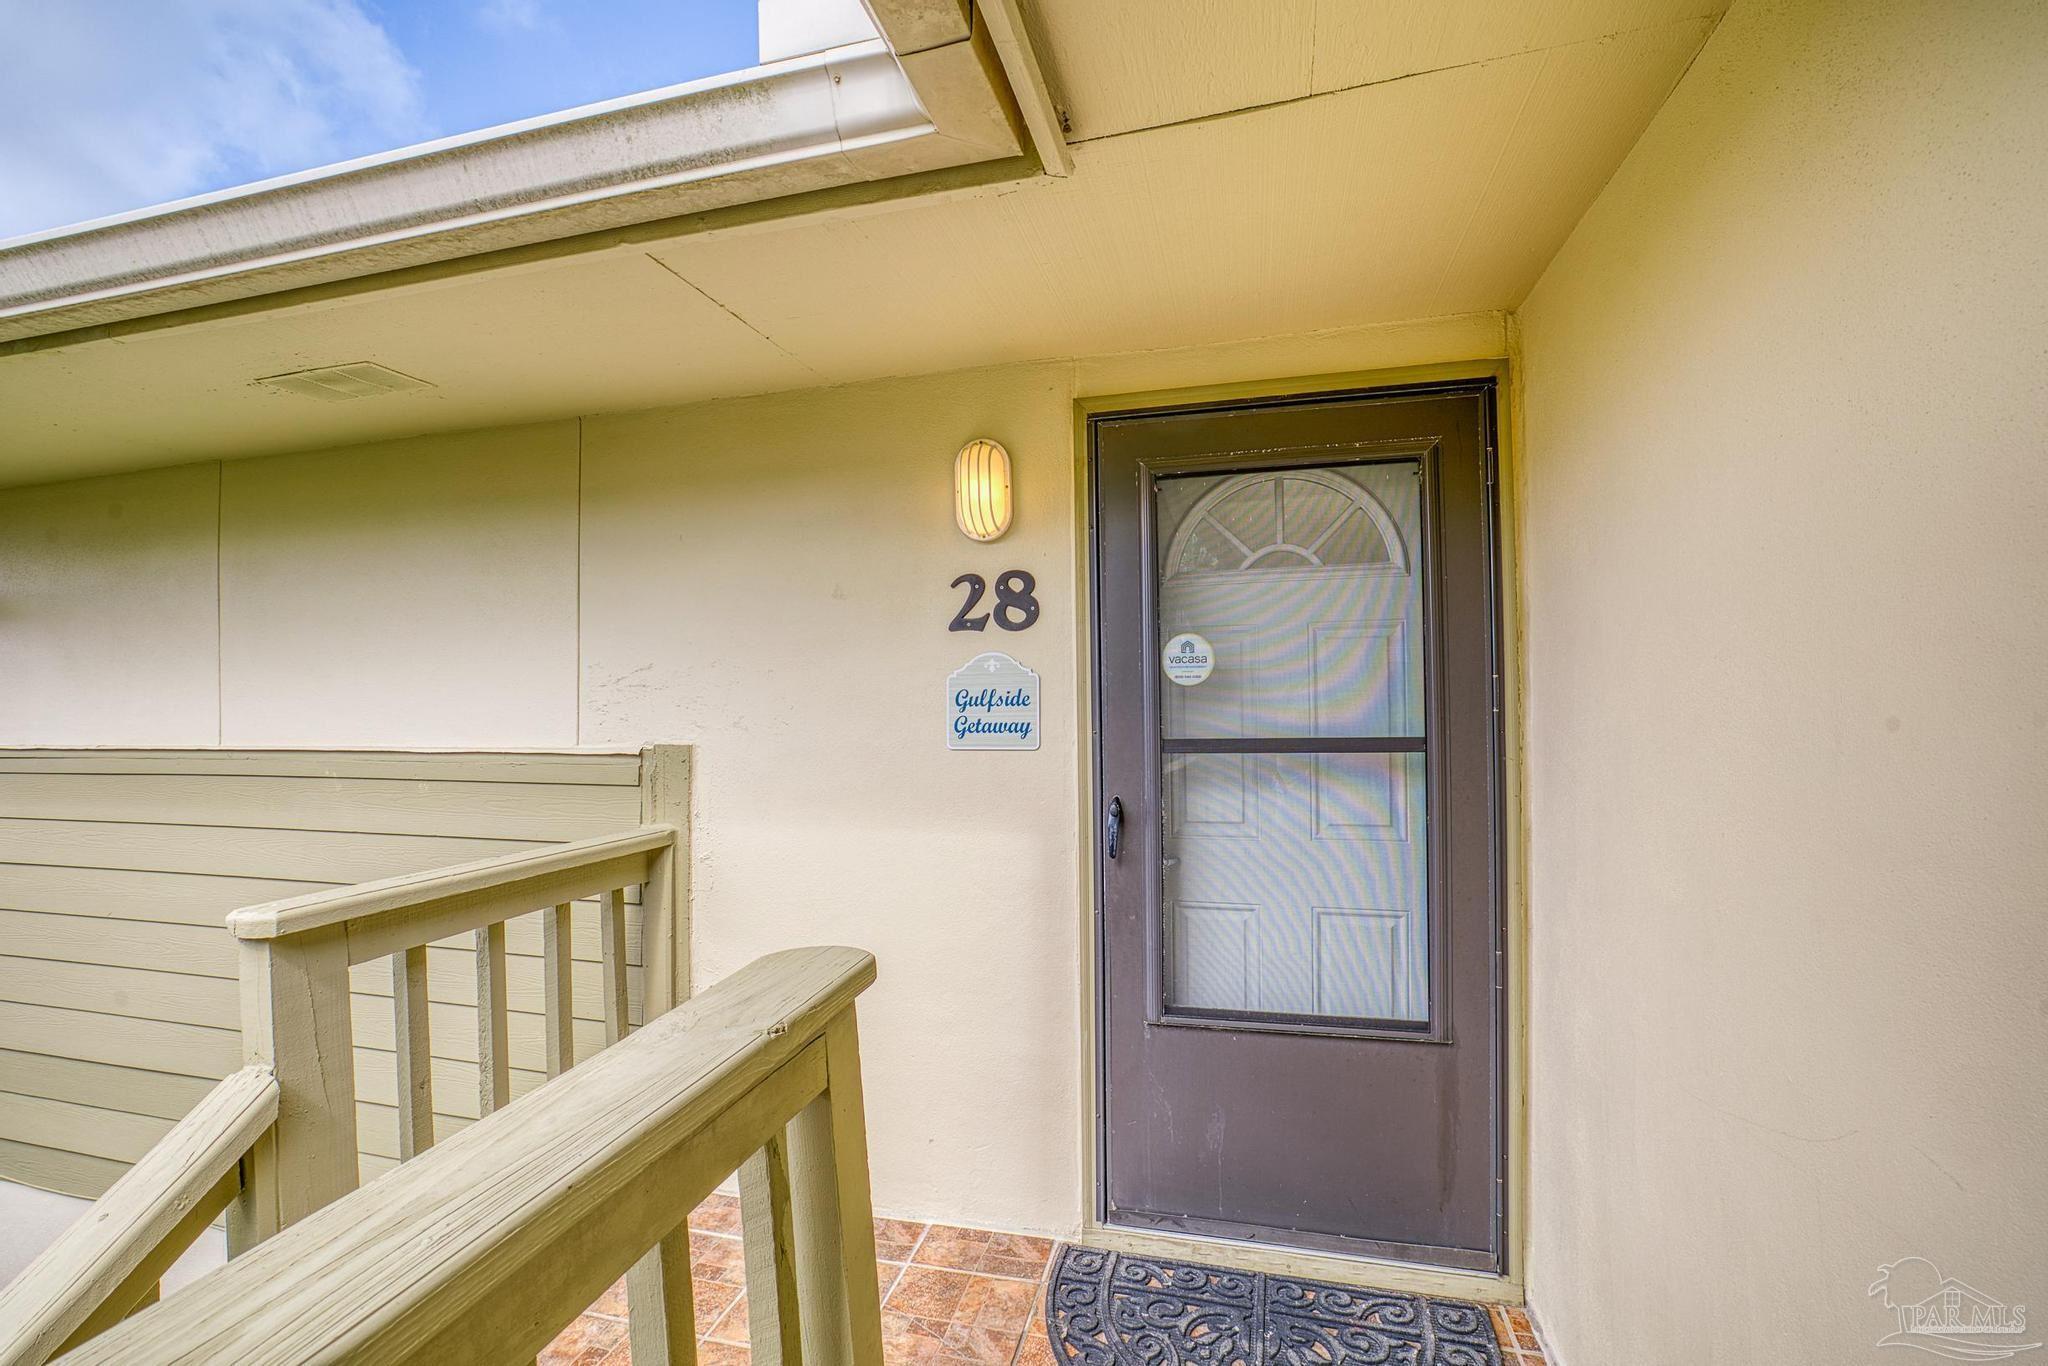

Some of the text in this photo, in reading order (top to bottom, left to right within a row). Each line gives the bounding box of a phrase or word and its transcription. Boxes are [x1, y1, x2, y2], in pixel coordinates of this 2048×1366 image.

[948, 569, 1040, 632] 28
[1168, 655, 1208, 664] vacasa
[955, 688, 1031, 713] Gulfside
[954, 715, 1032, 740] Getaway
